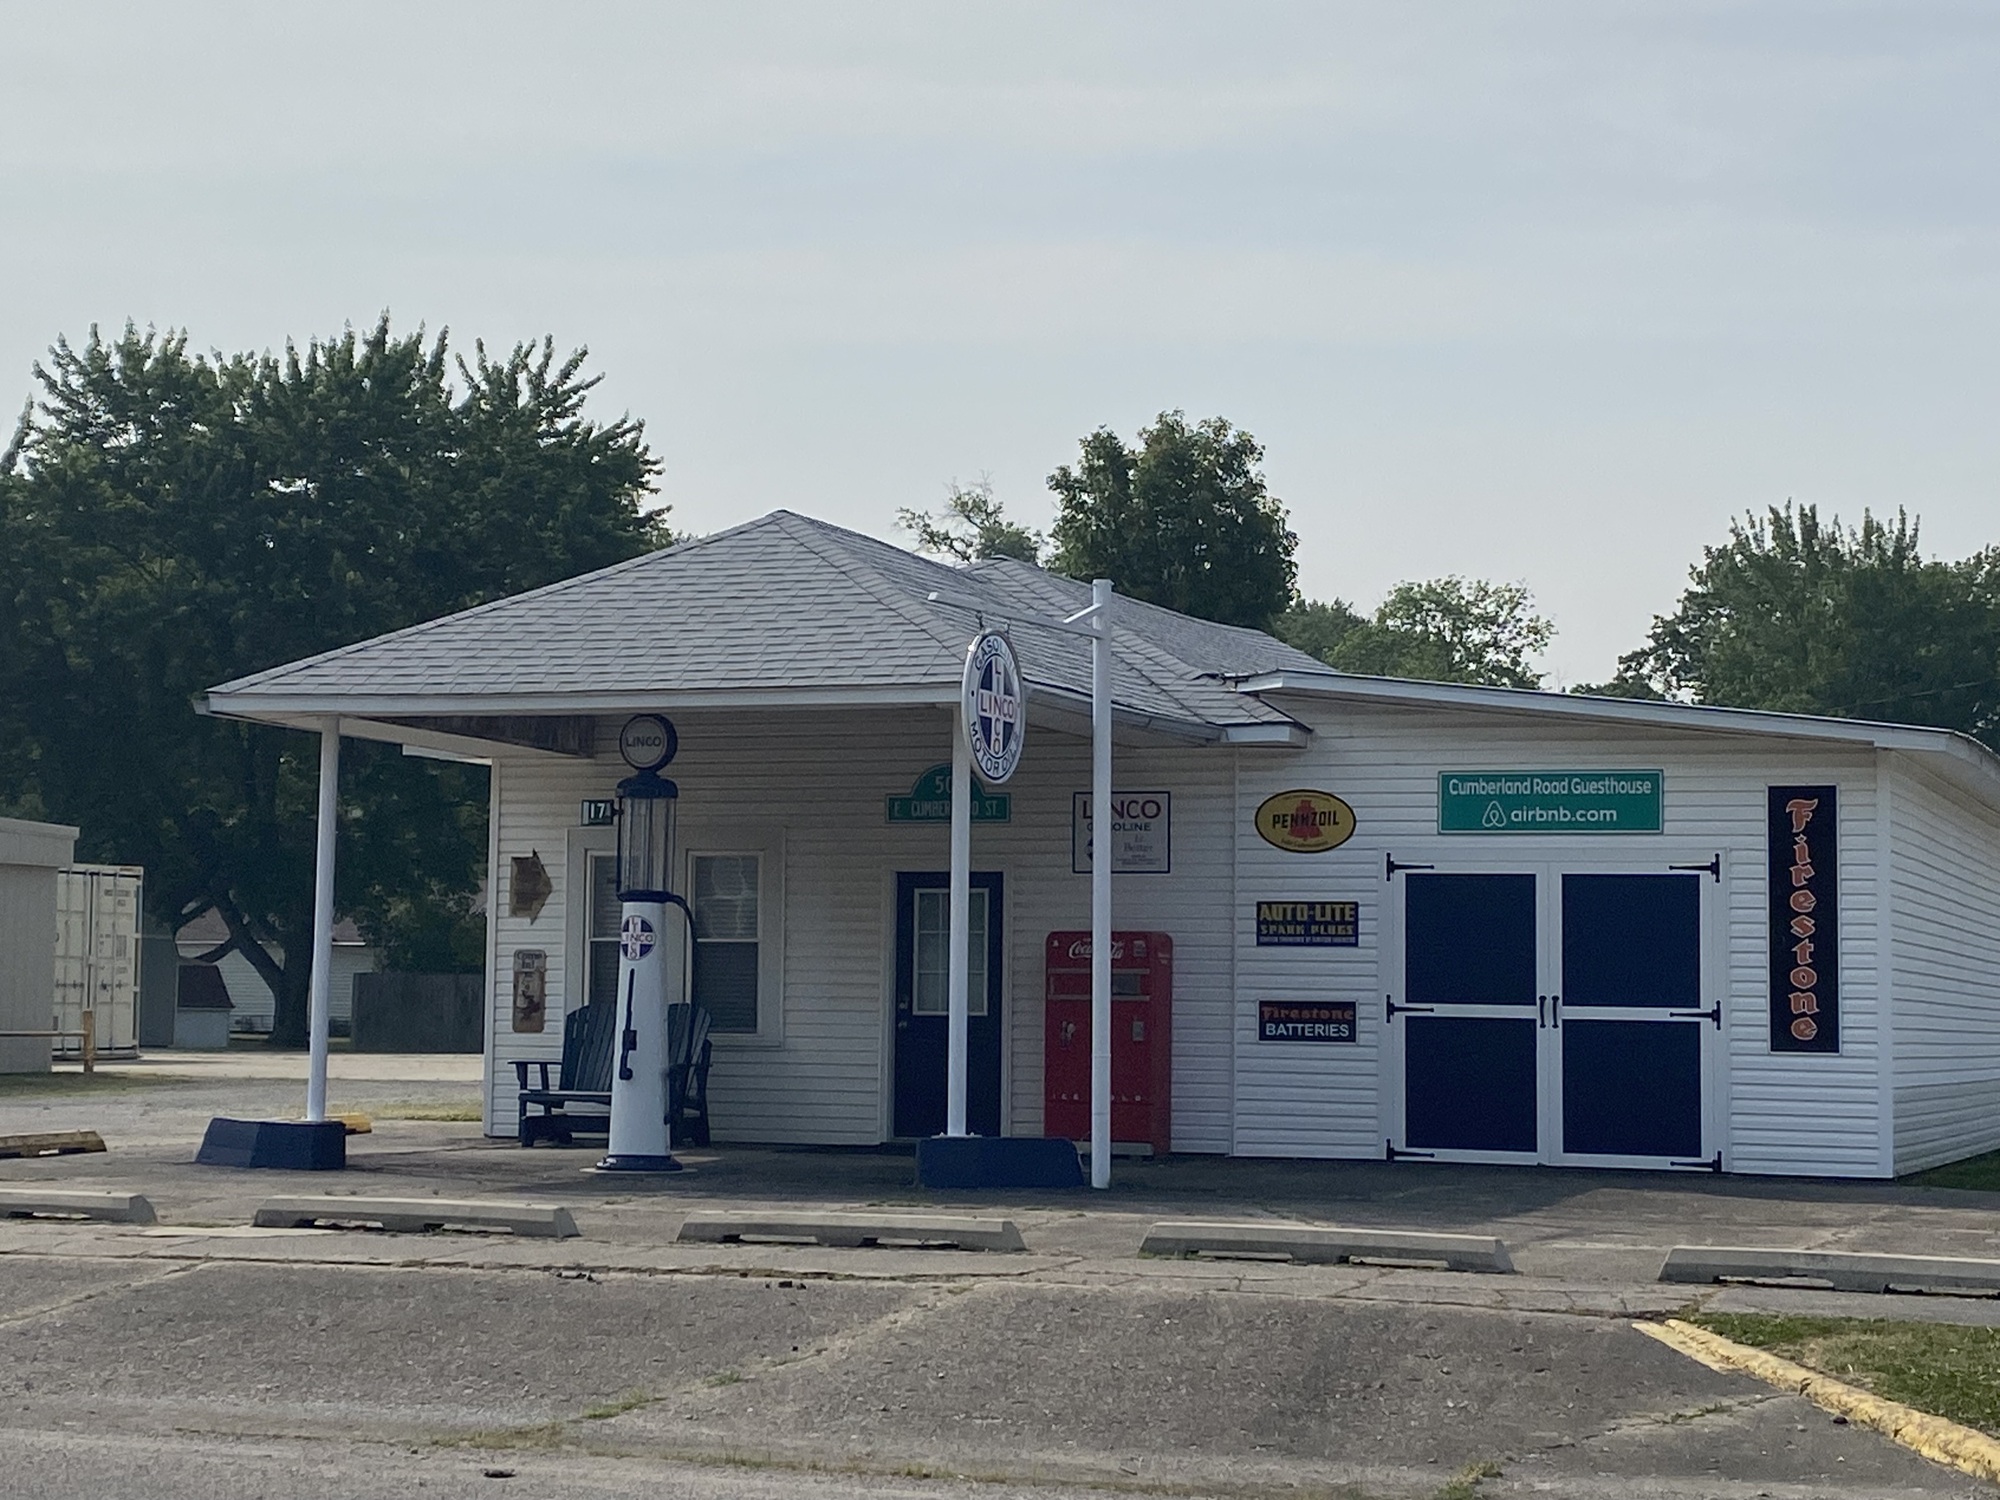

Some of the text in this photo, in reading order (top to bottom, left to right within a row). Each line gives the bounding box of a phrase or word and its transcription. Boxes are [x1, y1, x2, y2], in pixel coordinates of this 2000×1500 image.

[980, 692, 1013, 718] LINCO
[626, 736, 662, 747] LINCO
[971, 721, 1000, 775] MOTOR
[1448, 777, 1652, 795] Cumberland Road Guesthouse
[911, 801, 979, 817] CUMBERD
[1083, 800, 1162, 819] LNCO
[1511, 805, 1617, 822] airbnb.com
[1087, 822, 1152, 831] GOLINE
[1272, 809, 1340, 830] PENNZOIL
[1260, 903, 1355, 921] AUTO-LITE
[1785, 798, 1820, 1041] Firestone
[1260, 925, 1354, 935] SPARK PLUGS
[1261, 1006, 1354, 1020] Firestone
[1265, 1023, 1349, 1037] BATTERIES
